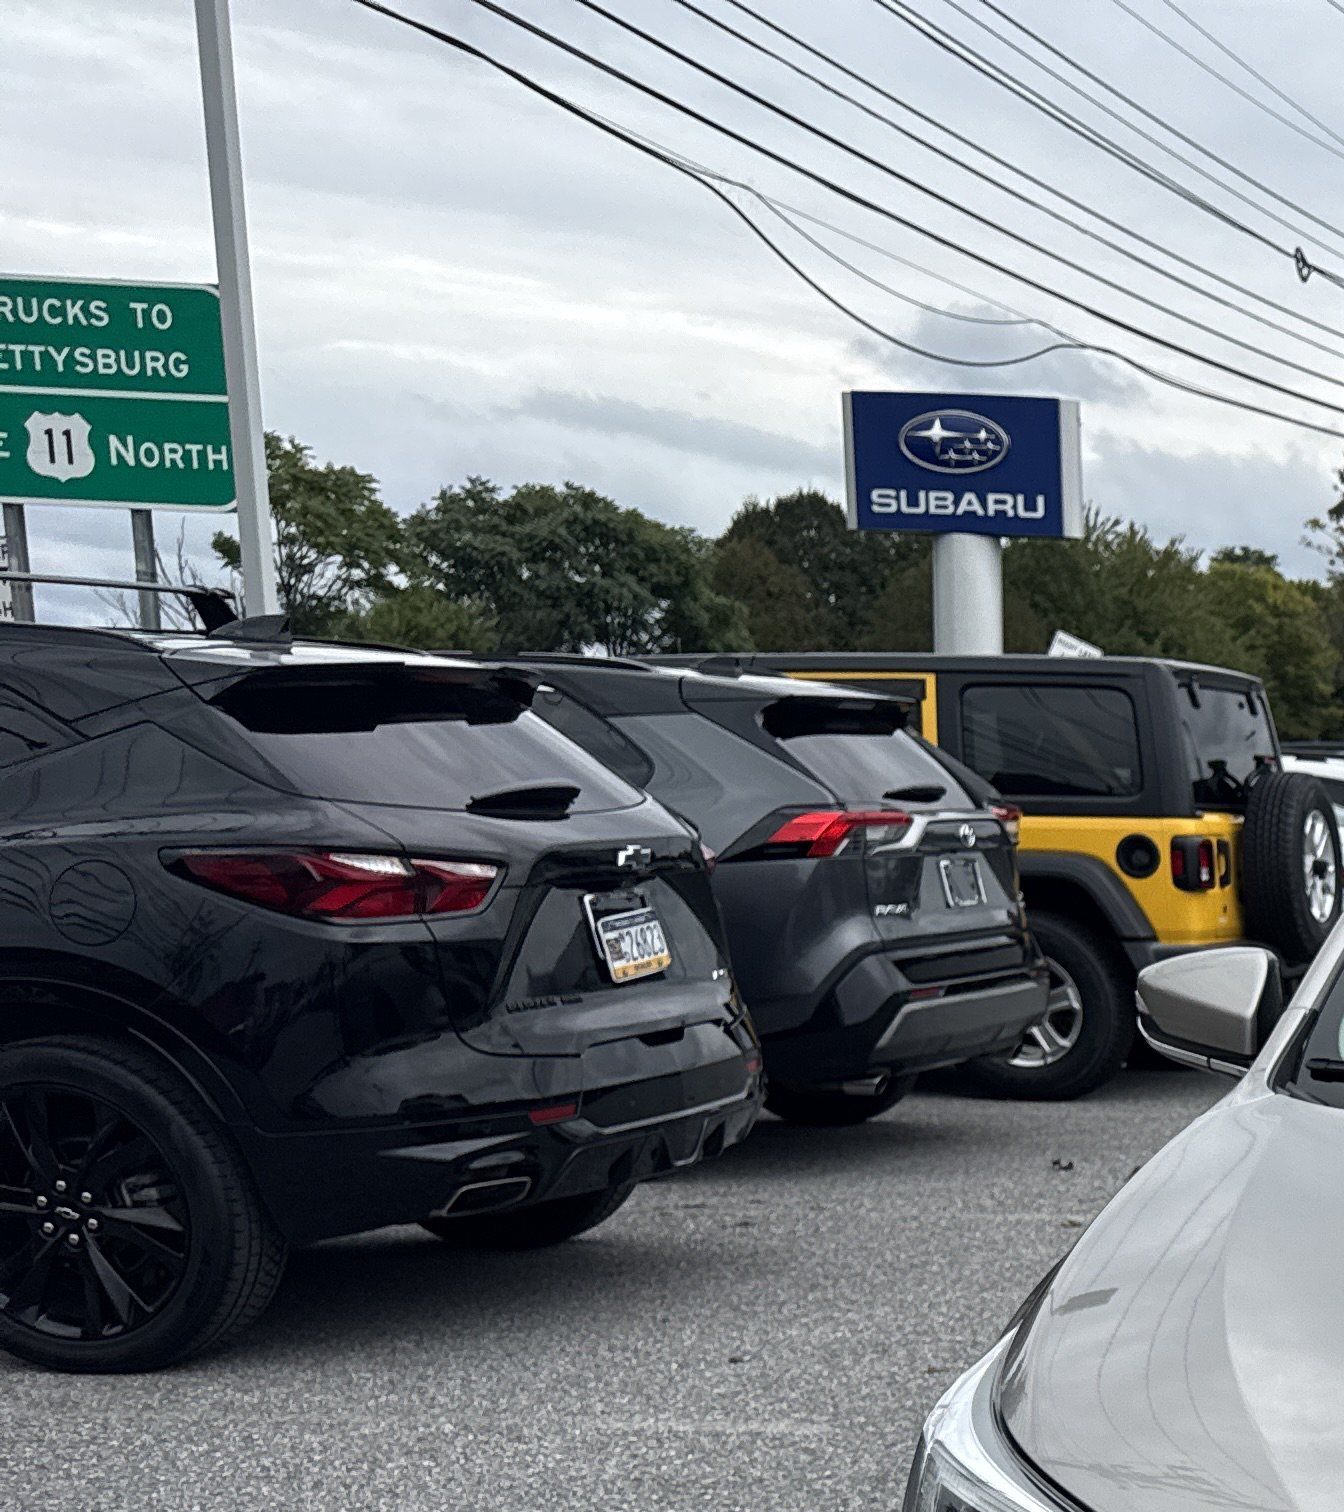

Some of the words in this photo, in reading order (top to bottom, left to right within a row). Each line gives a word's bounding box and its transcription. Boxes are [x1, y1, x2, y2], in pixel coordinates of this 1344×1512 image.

[129, 302, 173, 330] TO
[44, 427, 74, 465] 11
[108, 434, 229, 471] NORTH
[870, 487, 1046, 519] SUBARU
